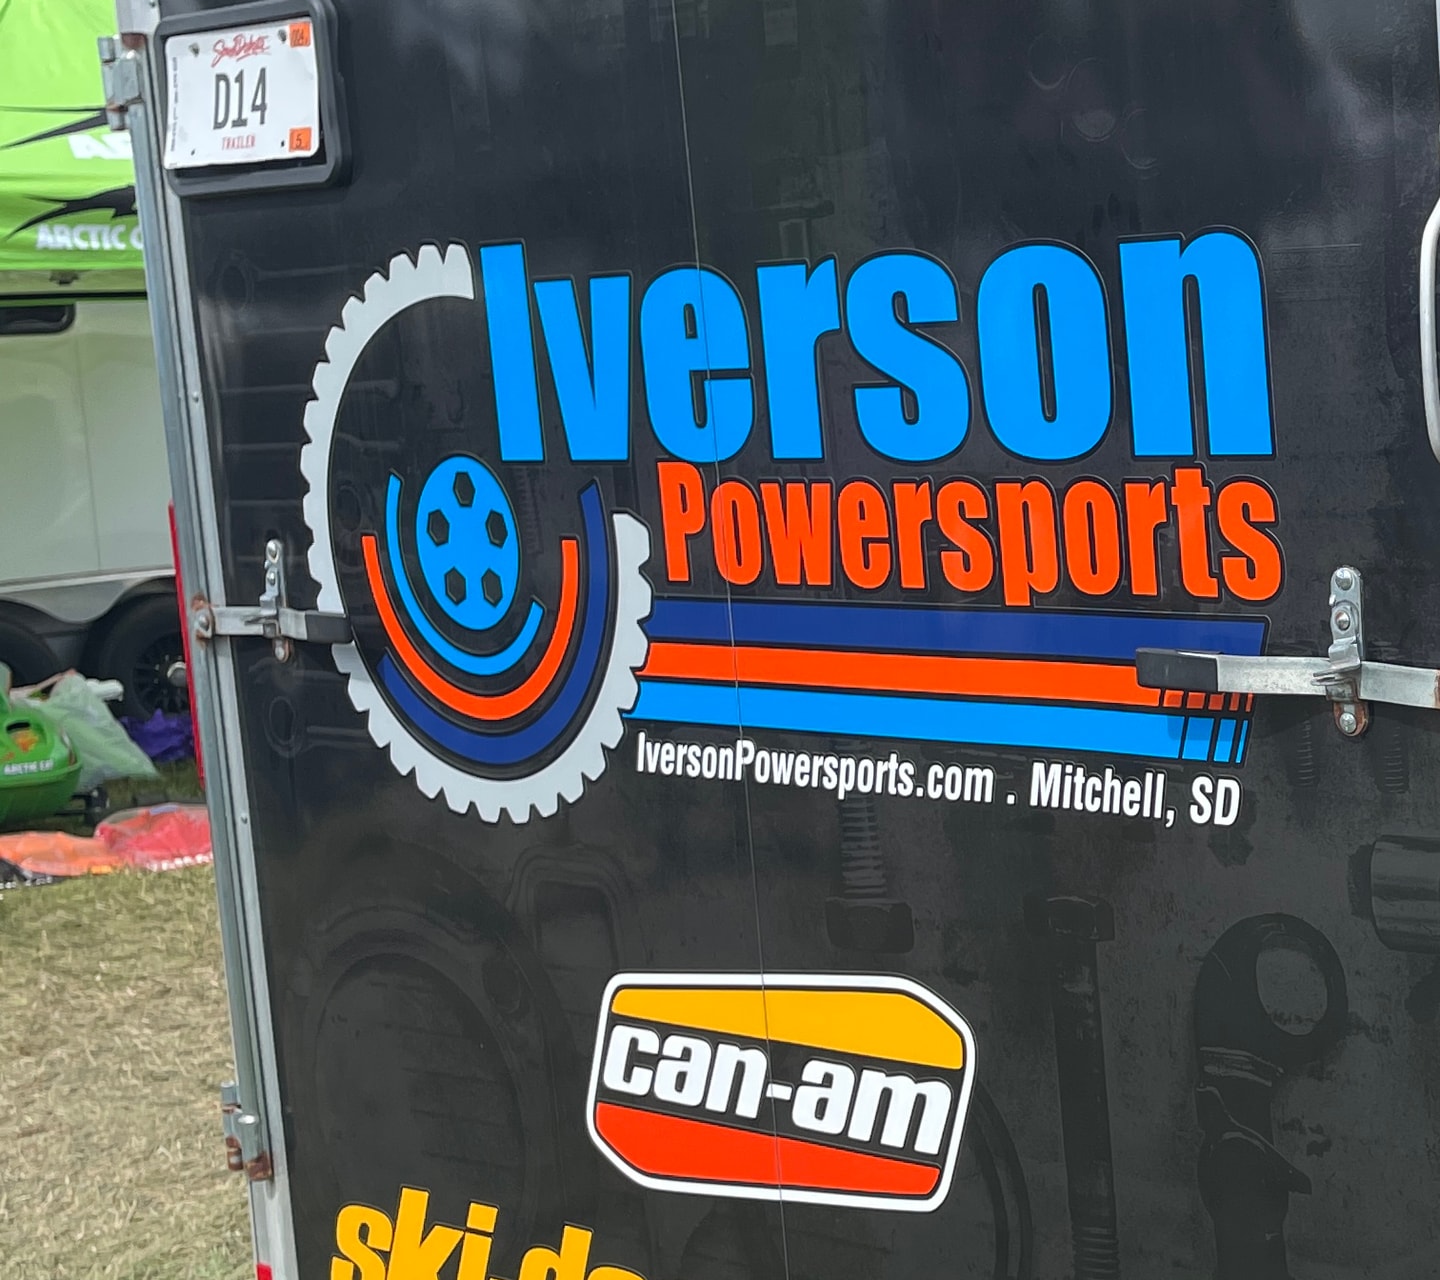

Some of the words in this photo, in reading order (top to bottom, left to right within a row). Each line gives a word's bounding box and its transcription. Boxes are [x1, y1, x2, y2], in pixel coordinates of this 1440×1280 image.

[213, 67, 268, 130] D14
[221, 134, 256, 151] TRAILER
[36, 223, 127, 251] ARCTIC
[479, 231, 1274, 464] Iverson
[656, 461, 1282, 607] Powersports
[636, 731, 995, 804] IversonPowersports.com
[1028, 761, 1176, 829] Mitchell,
[1188, 775, 1242, 827] SD
[602, 1023, 953, 1156] can-am
